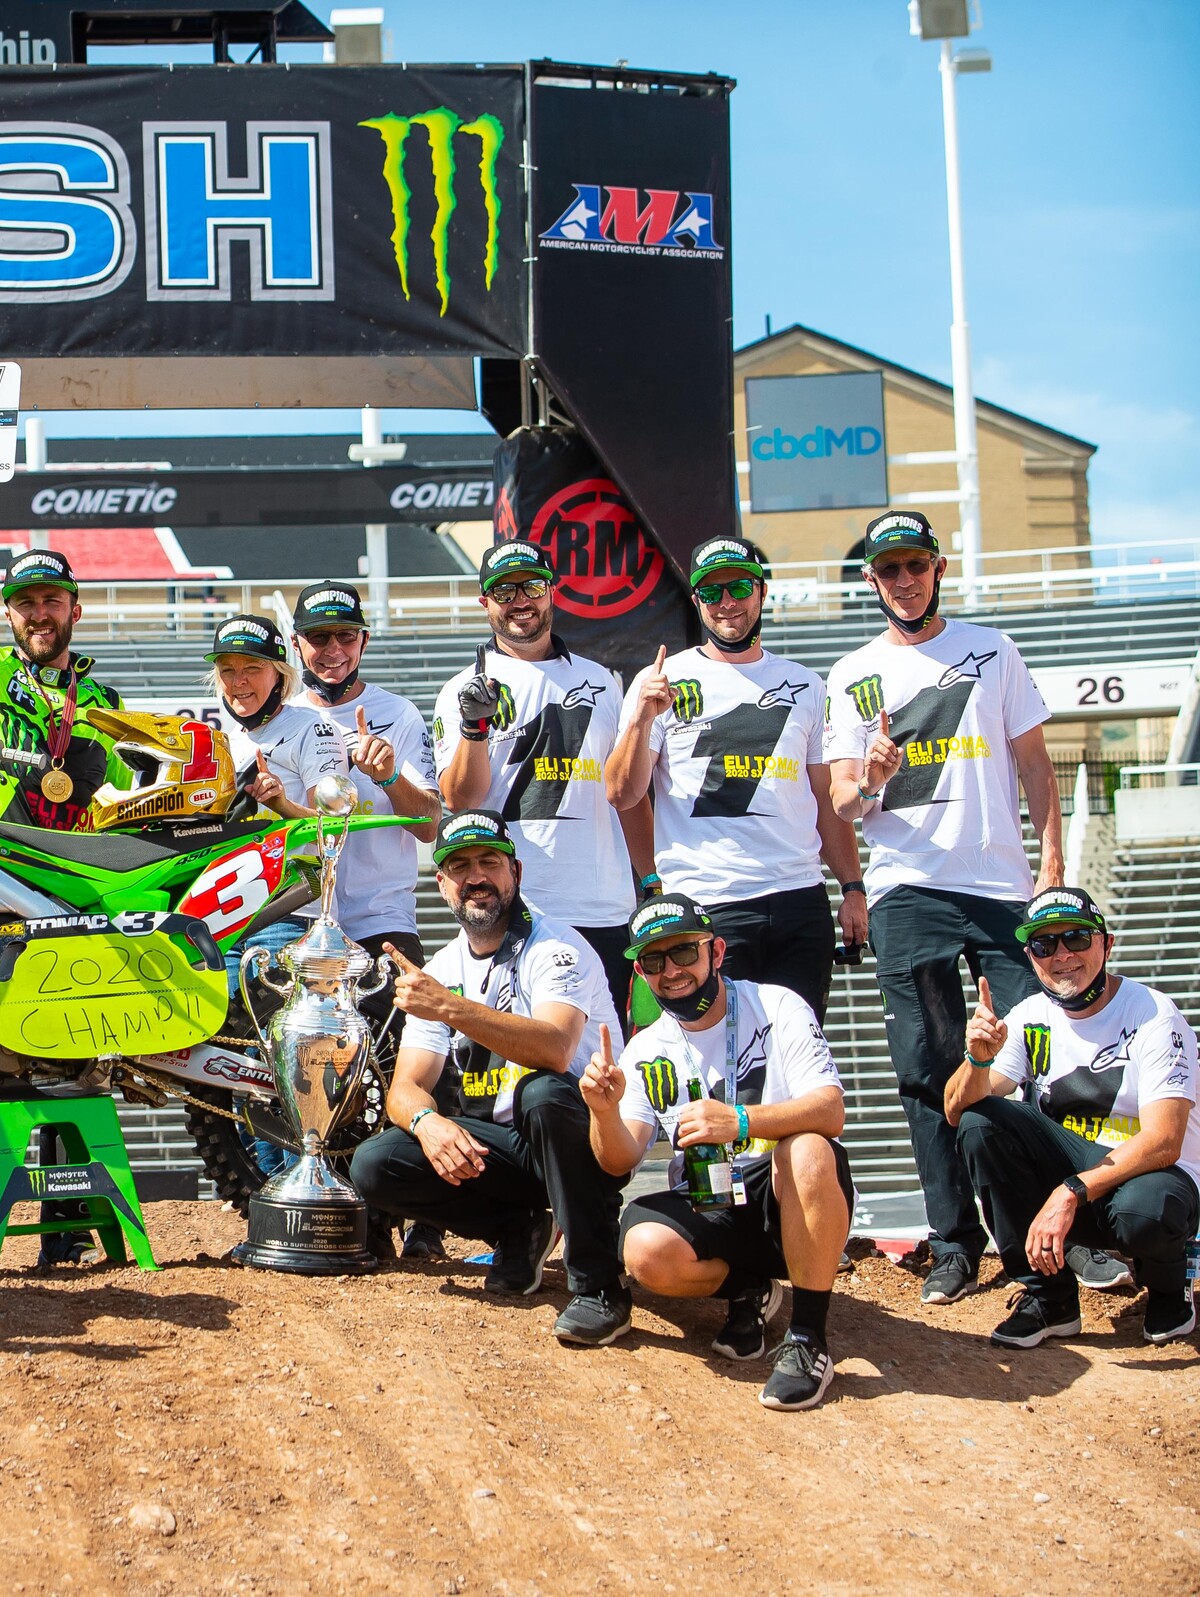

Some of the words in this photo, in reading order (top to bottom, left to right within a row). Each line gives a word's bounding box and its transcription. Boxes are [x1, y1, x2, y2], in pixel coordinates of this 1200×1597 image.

[538, 183, 725, 250] AMA
[539, 239, 589, 250] AMERICAN
[590, 243, 661, 256] MOTORCYCLIST
[662, 248, 724, 260] ASSOCIATION
[751, 424, 883, 461] cbdMD
[870, 515, 924, 542] CHAMPIONS
[557, 520, 642, 577] RM
[696, 540, 748, 567] CHAMPIONS
[11, 554, 64, 578] CHAMPIONS
[303, 590, 356, 611] CHAMPIONS
[218, 620, 269, 641] CHAMPIONS
[43, 669, 58, 683] 3
[1077, 675, 1125, 706] 26
[179, 720, 219, 785] 1
[907, 741, 933, 758] ELI
[534, 757, 559, 773] ELI
[724, 755, 750, 770] ELI
[754, 755, 799, 773] TOMAC
[909, 754, 932, 767] 2020
[536, 771, 557, 781] 2020
[560, 772, 570, 781] SX
[725, 769, 748, 778] 2020
[751, 769, 763, 778] SX
[26, 791, 58, 819] ELI
[117, 792, 185, 820] CHAMPION
[193, 791, 214, 802] BELL
[173, 824, 223, 838] Kawasaki
[442, 814, 499, 840] CHAMPIONS
[174, 848, 213, 867] 450
[190, 849, 270, 936] 3
[1028, 891, 1083, 919] CHAMPIONS
[123, 911, 156, 932] 3
[632, 903, 684, 935] CHAMPIONS
[29, 946, 174, 994] 2020
[149, 1055, 167, 1066] DIRT
[168, 1060, 188, 1069] STAR
[464, 1086, 484, 1097] 2020
[486, 1085, 497, 1095] SX
[48, 1170, 88, 1179] MONSTER
[47, 1181, 91, 1192] Kawasaki
[265, 1239, 288, 1247] WORLD
